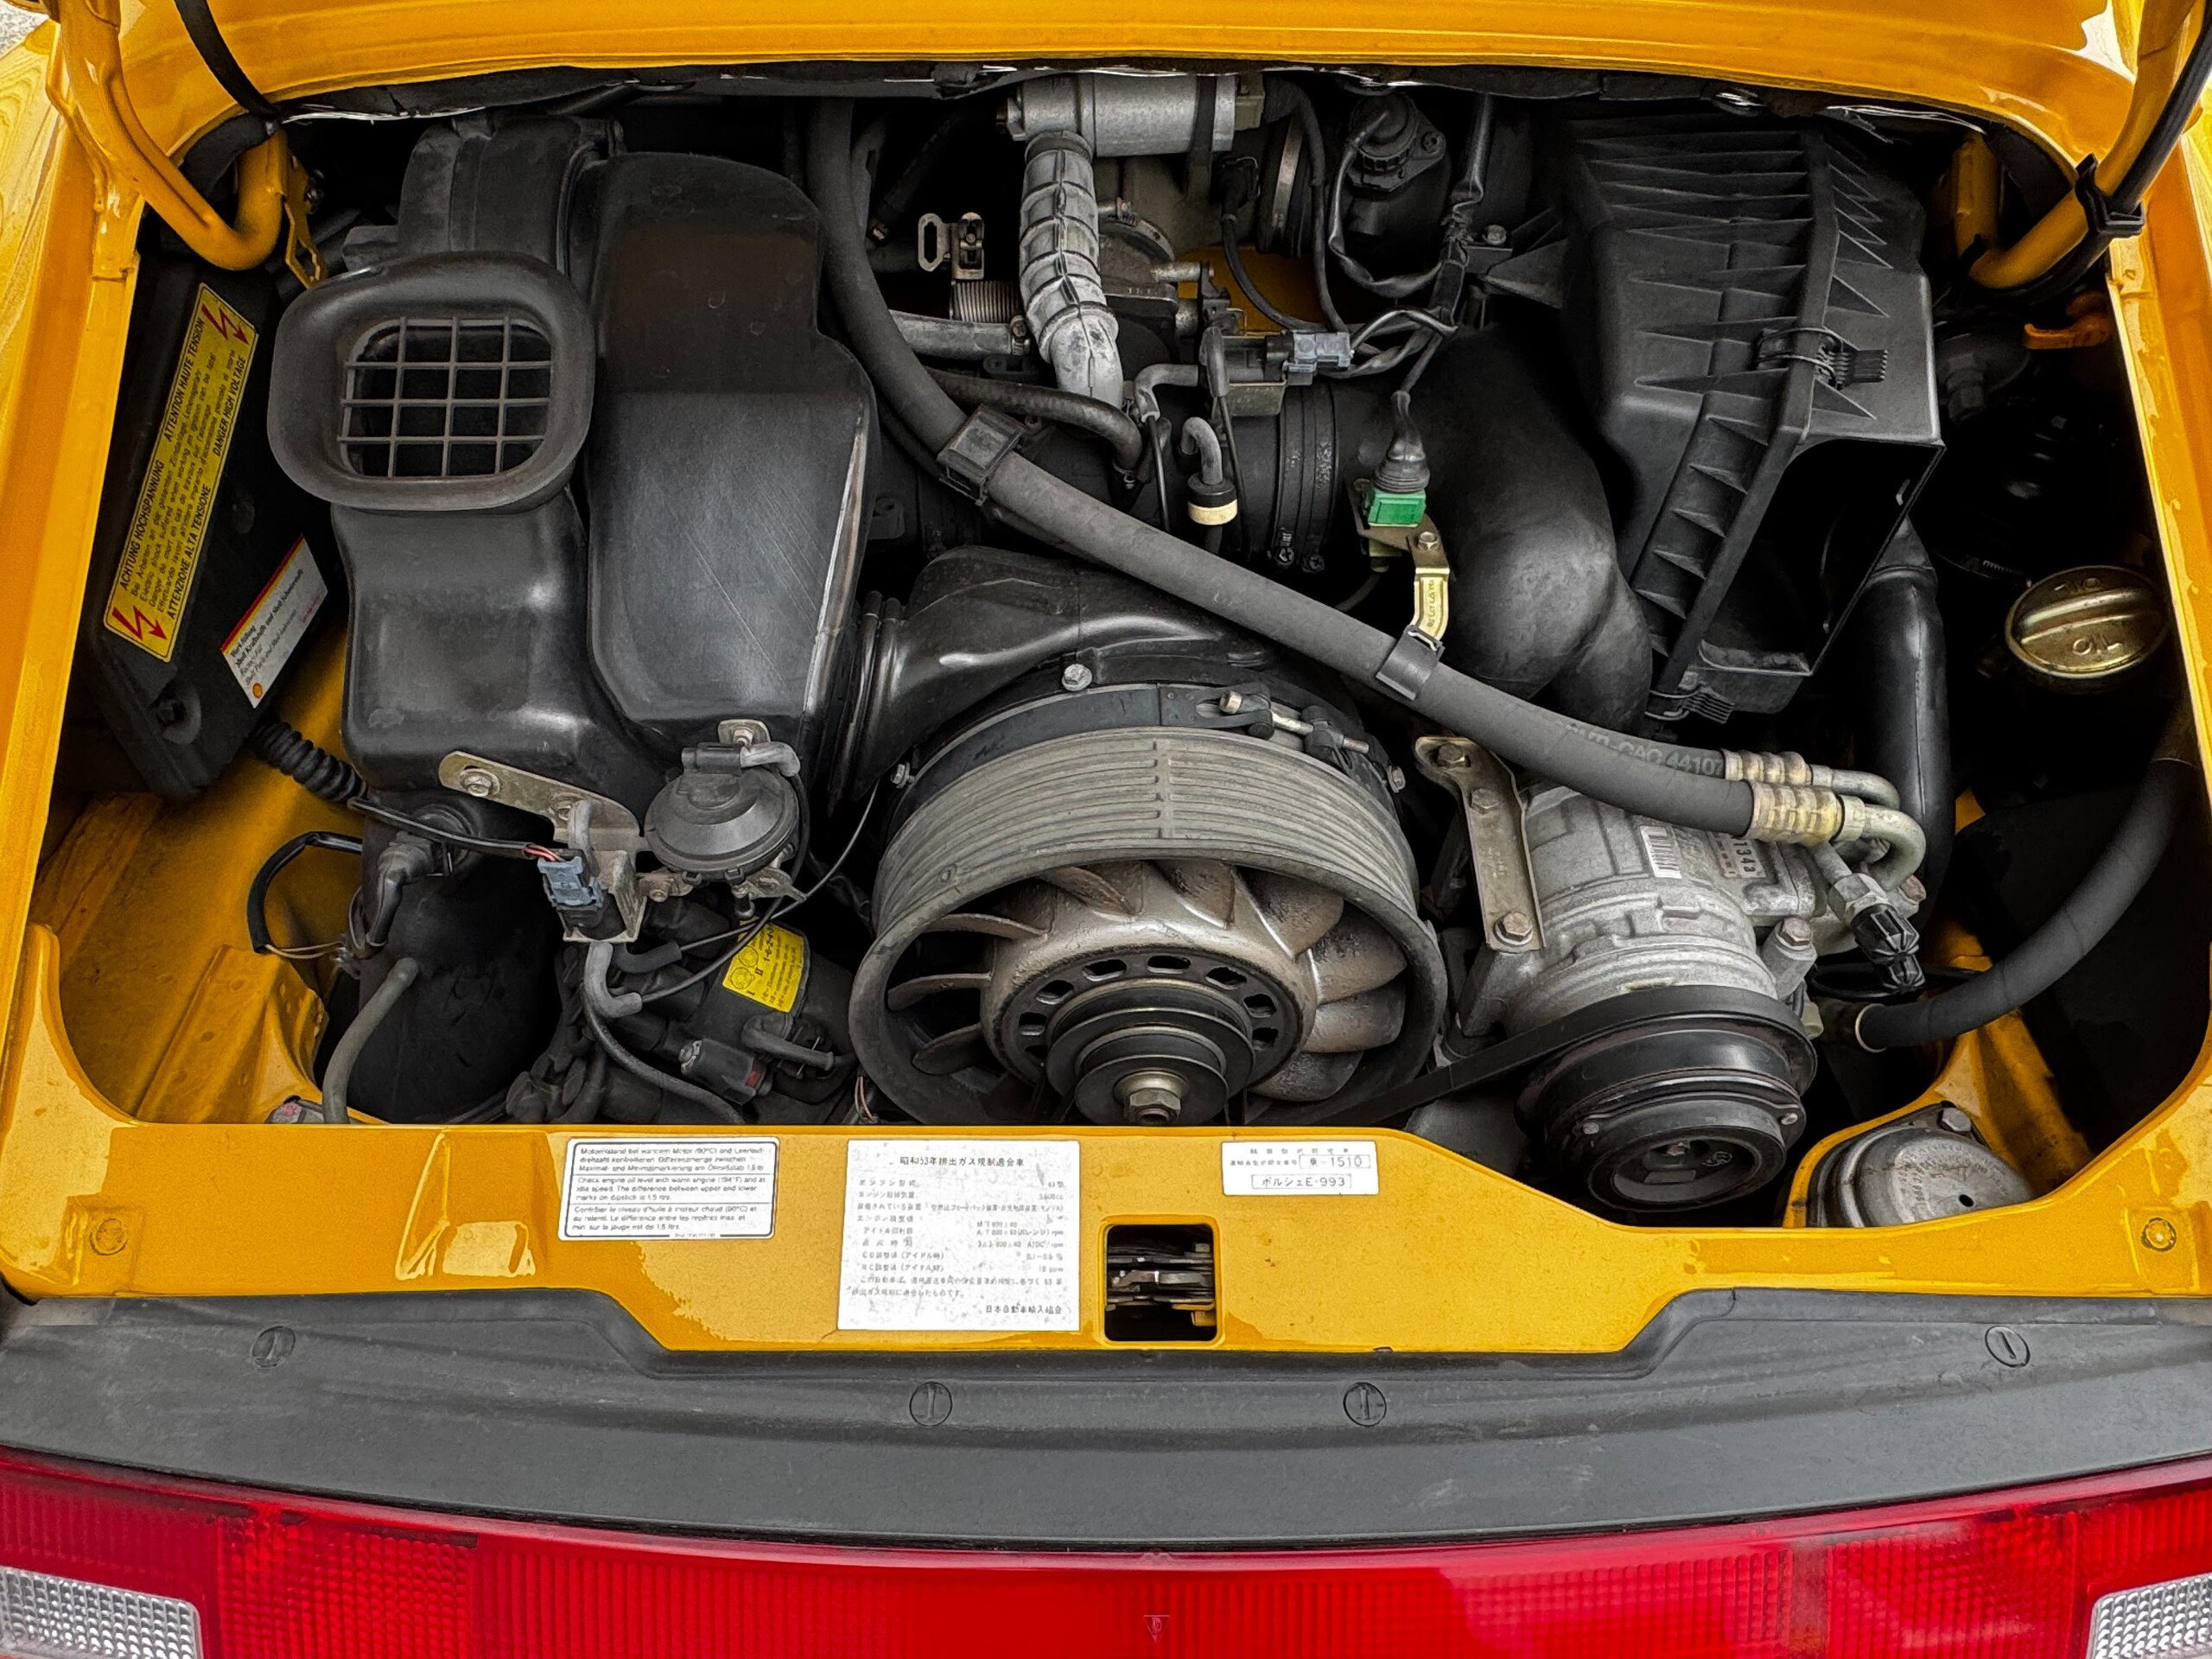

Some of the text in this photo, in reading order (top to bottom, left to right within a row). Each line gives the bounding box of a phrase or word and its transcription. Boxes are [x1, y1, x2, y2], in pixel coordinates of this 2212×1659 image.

[164, 318, 204, 441] ATTENTION HAUTE TENSION
[213, 355, 245, 455] DANGER HIGH VOLTAGE
[120, 460, 163, 589] ACHTUNG HOCHSPANNUNG
[151, 543, 161, 567] shock
[159, 505, 172, 538] suffered
[167, 485, 210, 618] ATTENZIONE ALTA TENSIONE
[149, 578, 161, 607] Danger
[2072, 632, 2122, 655] OIL
